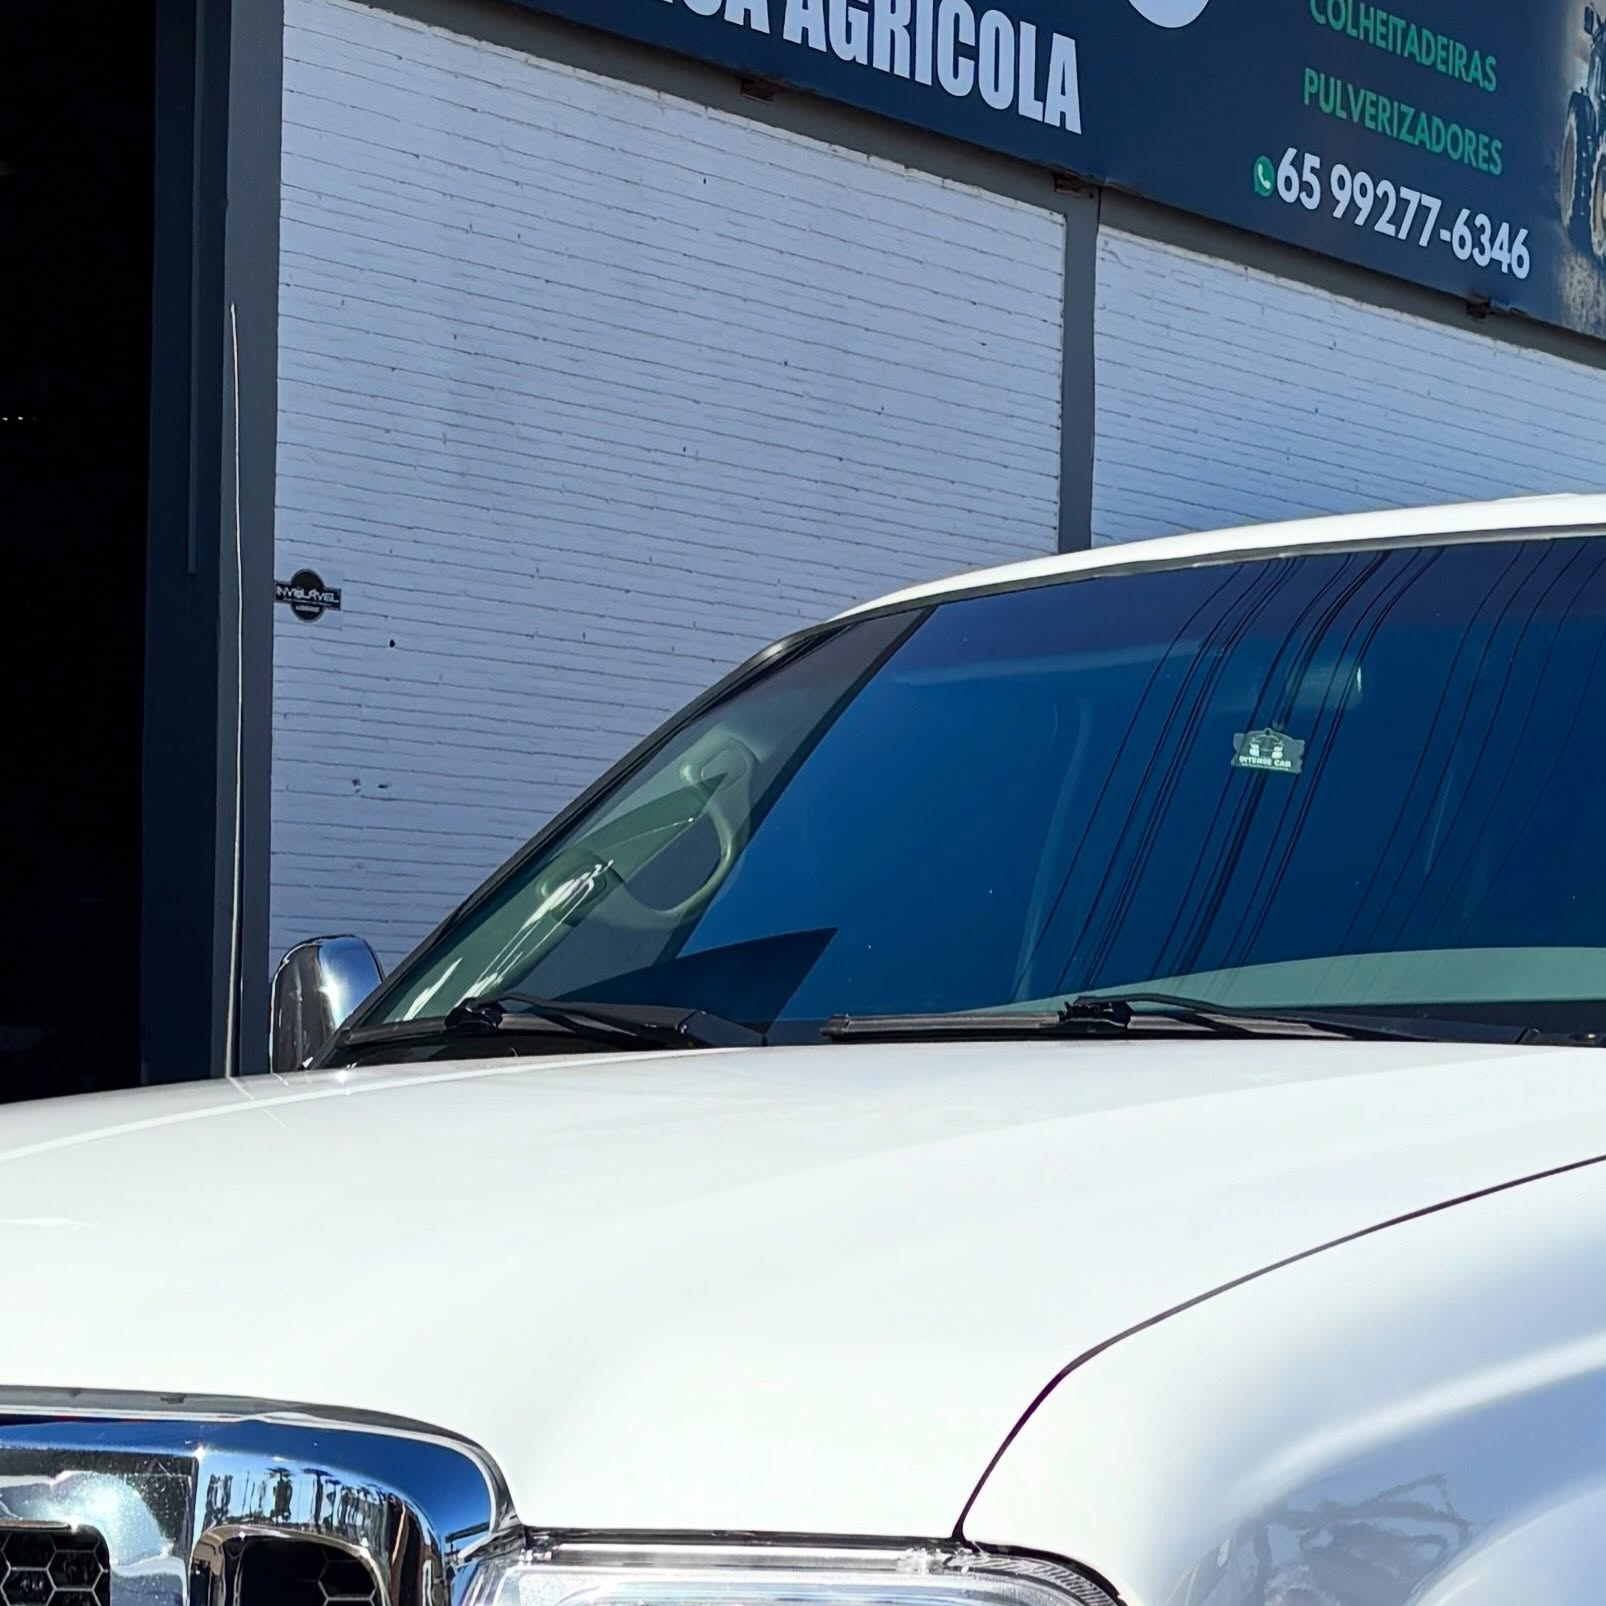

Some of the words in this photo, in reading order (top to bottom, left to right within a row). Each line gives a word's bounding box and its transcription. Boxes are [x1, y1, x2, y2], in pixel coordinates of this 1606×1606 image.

[1309, 0, 1498, 93] COLHEITADEIRAS
[1303, 66, 1503, 177] PULVERIZADORES
[1275, 146, 1321, 211] 65
[1329, 162, 1531, 280] 99277-6346
